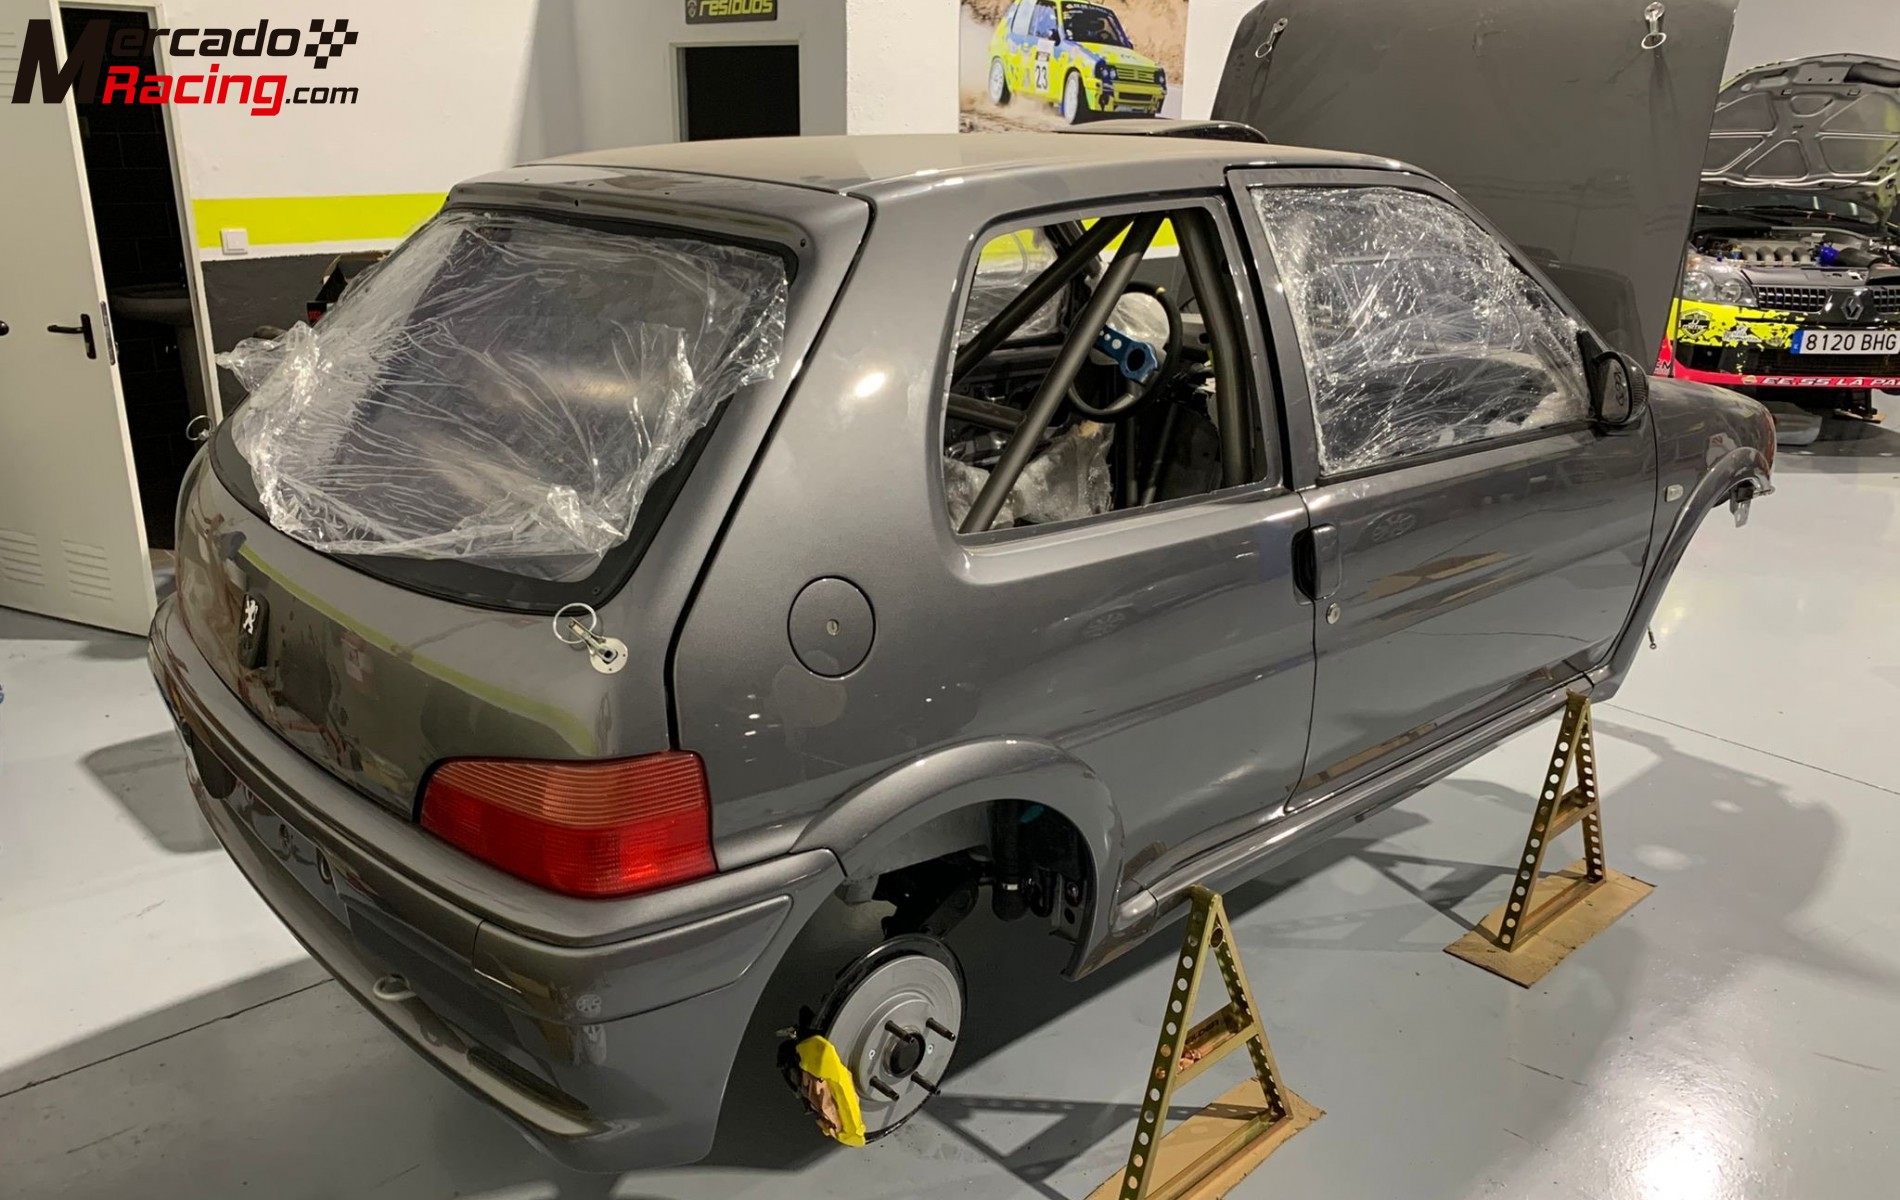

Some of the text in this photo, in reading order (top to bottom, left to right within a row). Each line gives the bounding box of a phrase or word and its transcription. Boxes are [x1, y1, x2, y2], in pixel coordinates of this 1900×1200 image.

[1035, 65, 1048, 89] 23
[1806, 334, 1856, 351] 8120
[1861, 334, 1897, 351] BHG
[1836, 377, 1863, 386] LA
